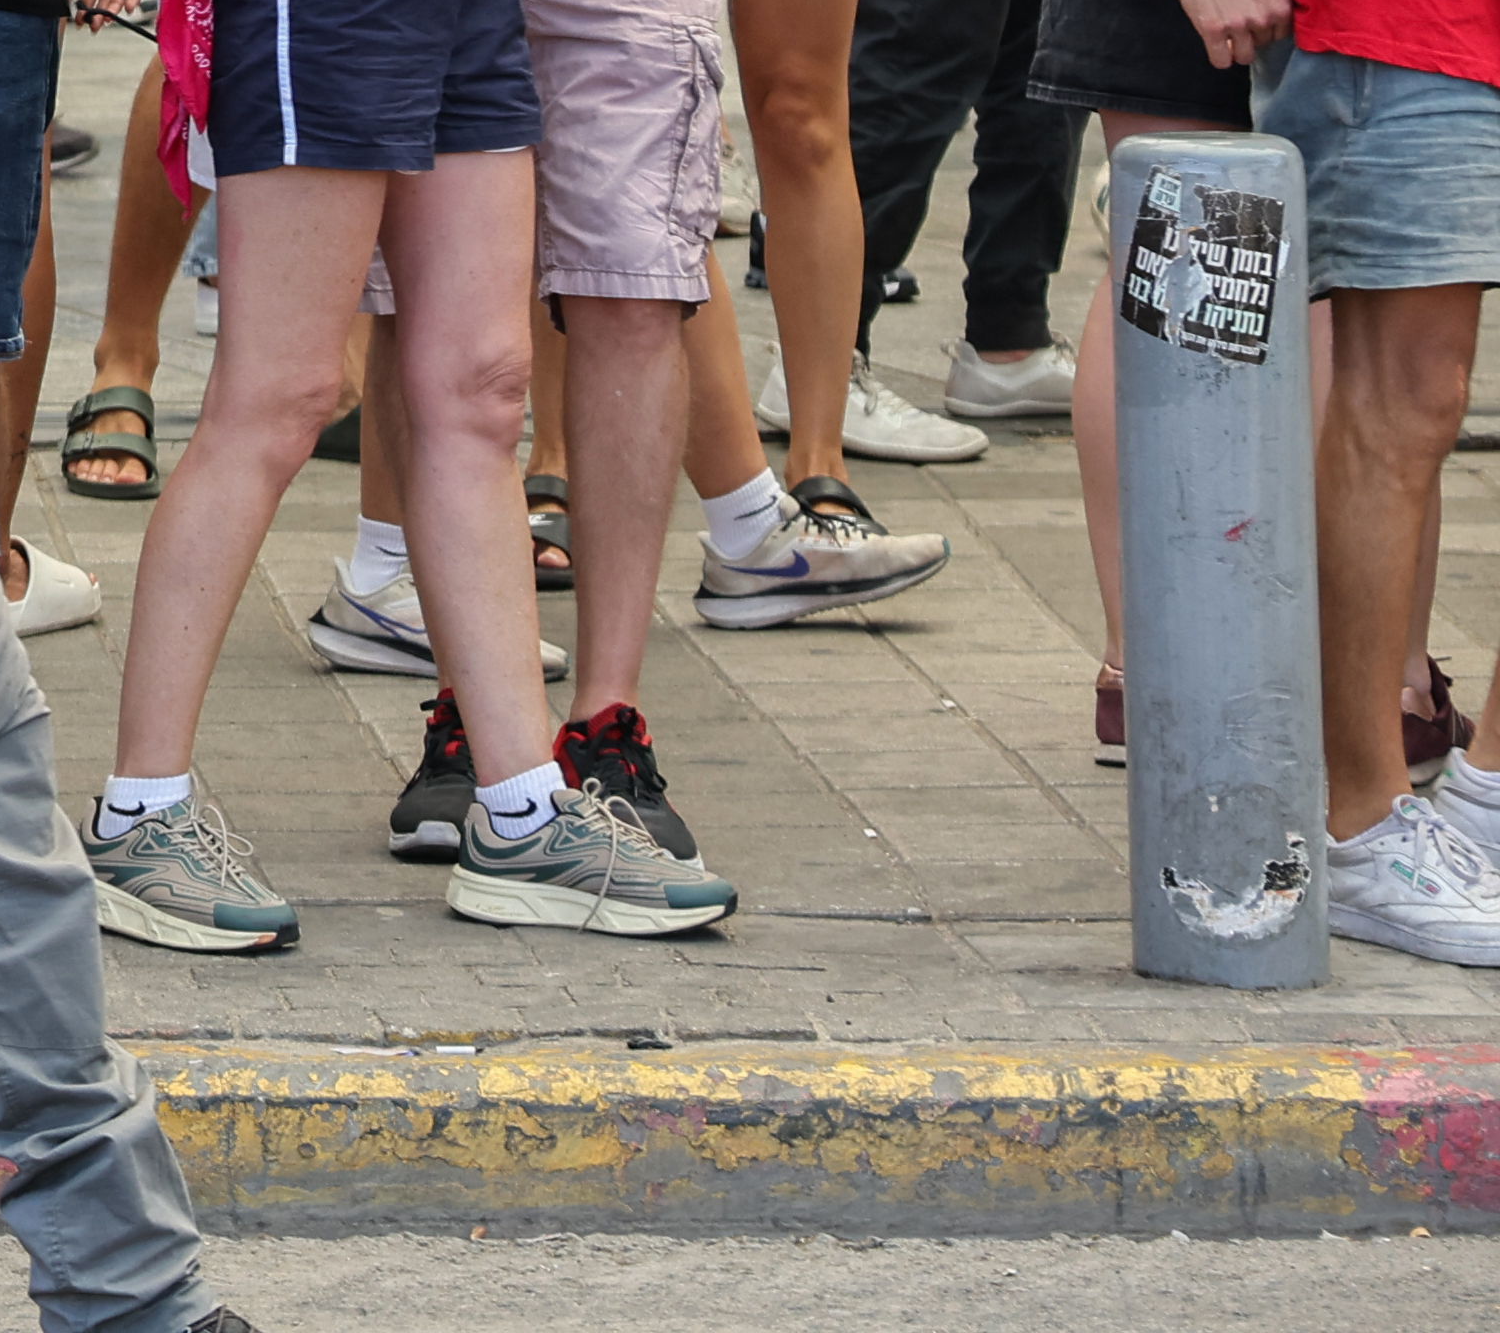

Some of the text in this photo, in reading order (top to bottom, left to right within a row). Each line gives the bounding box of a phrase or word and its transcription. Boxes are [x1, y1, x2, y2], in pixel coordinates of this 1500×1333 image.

[1230, 247, 1273, 278] בזמן
[1206, 272, 1270, 308] נלחמי
[1202, 302, 1266, 337] נתניהו
